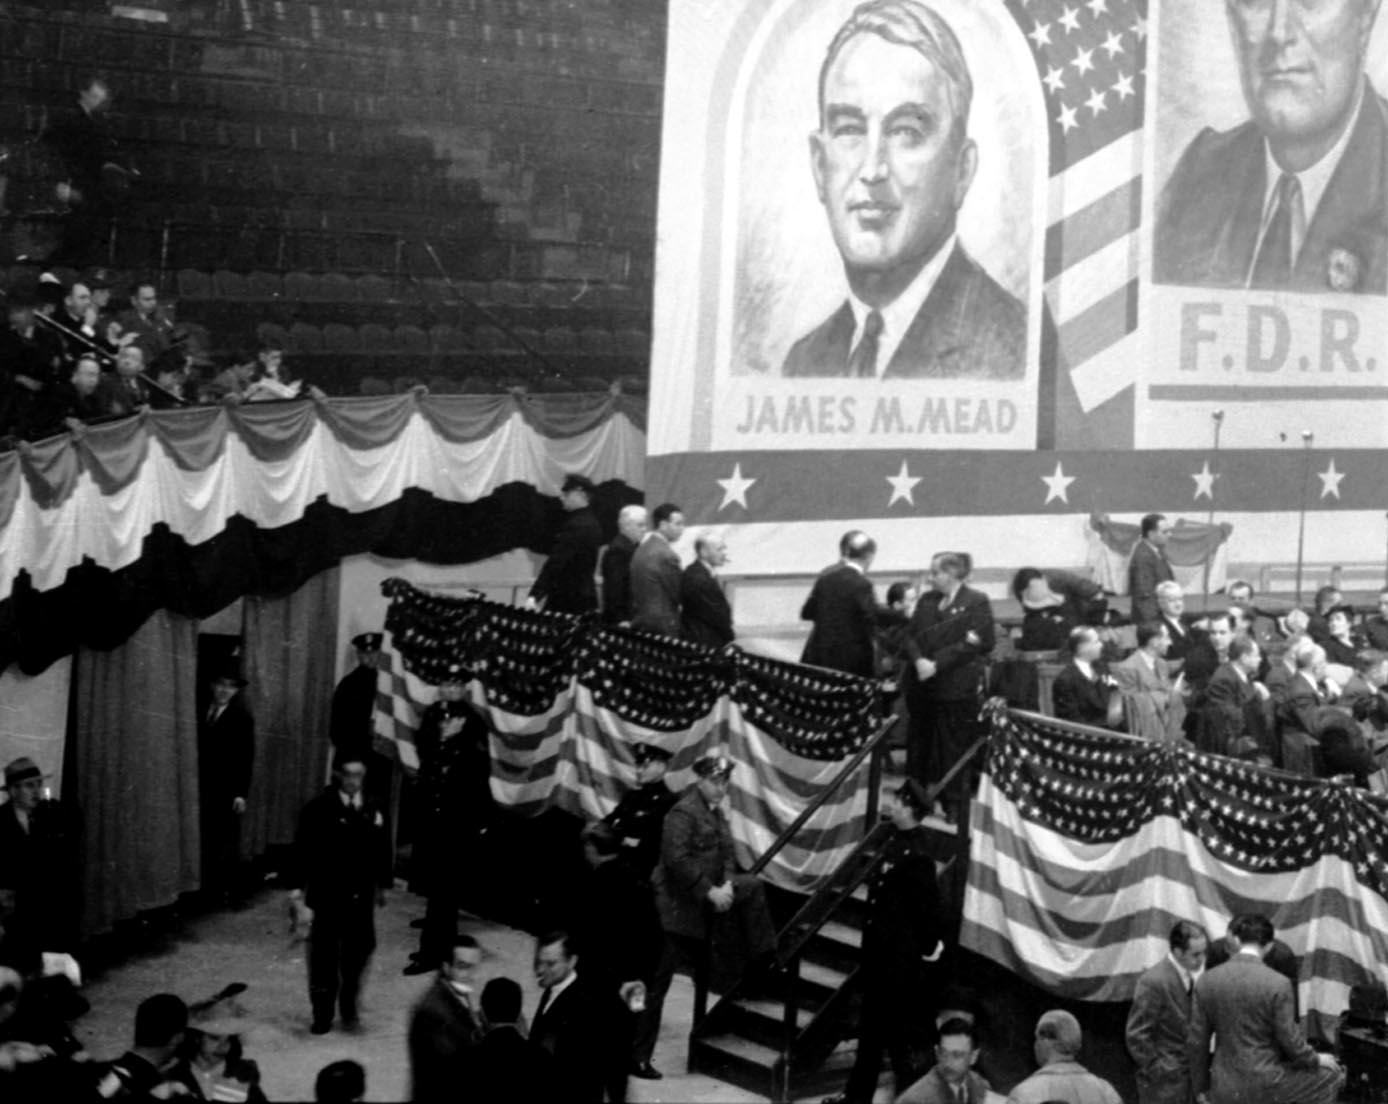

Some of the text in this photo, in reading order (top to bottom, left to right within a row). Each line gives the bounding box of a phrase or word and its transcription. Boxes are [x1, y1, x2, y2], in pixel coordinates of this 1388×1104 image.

[1178, 301, 1377, 374] F.D.R.
[736, 395, 858, 435] JAMES
[917, 397, 1019, 435] MEAD
